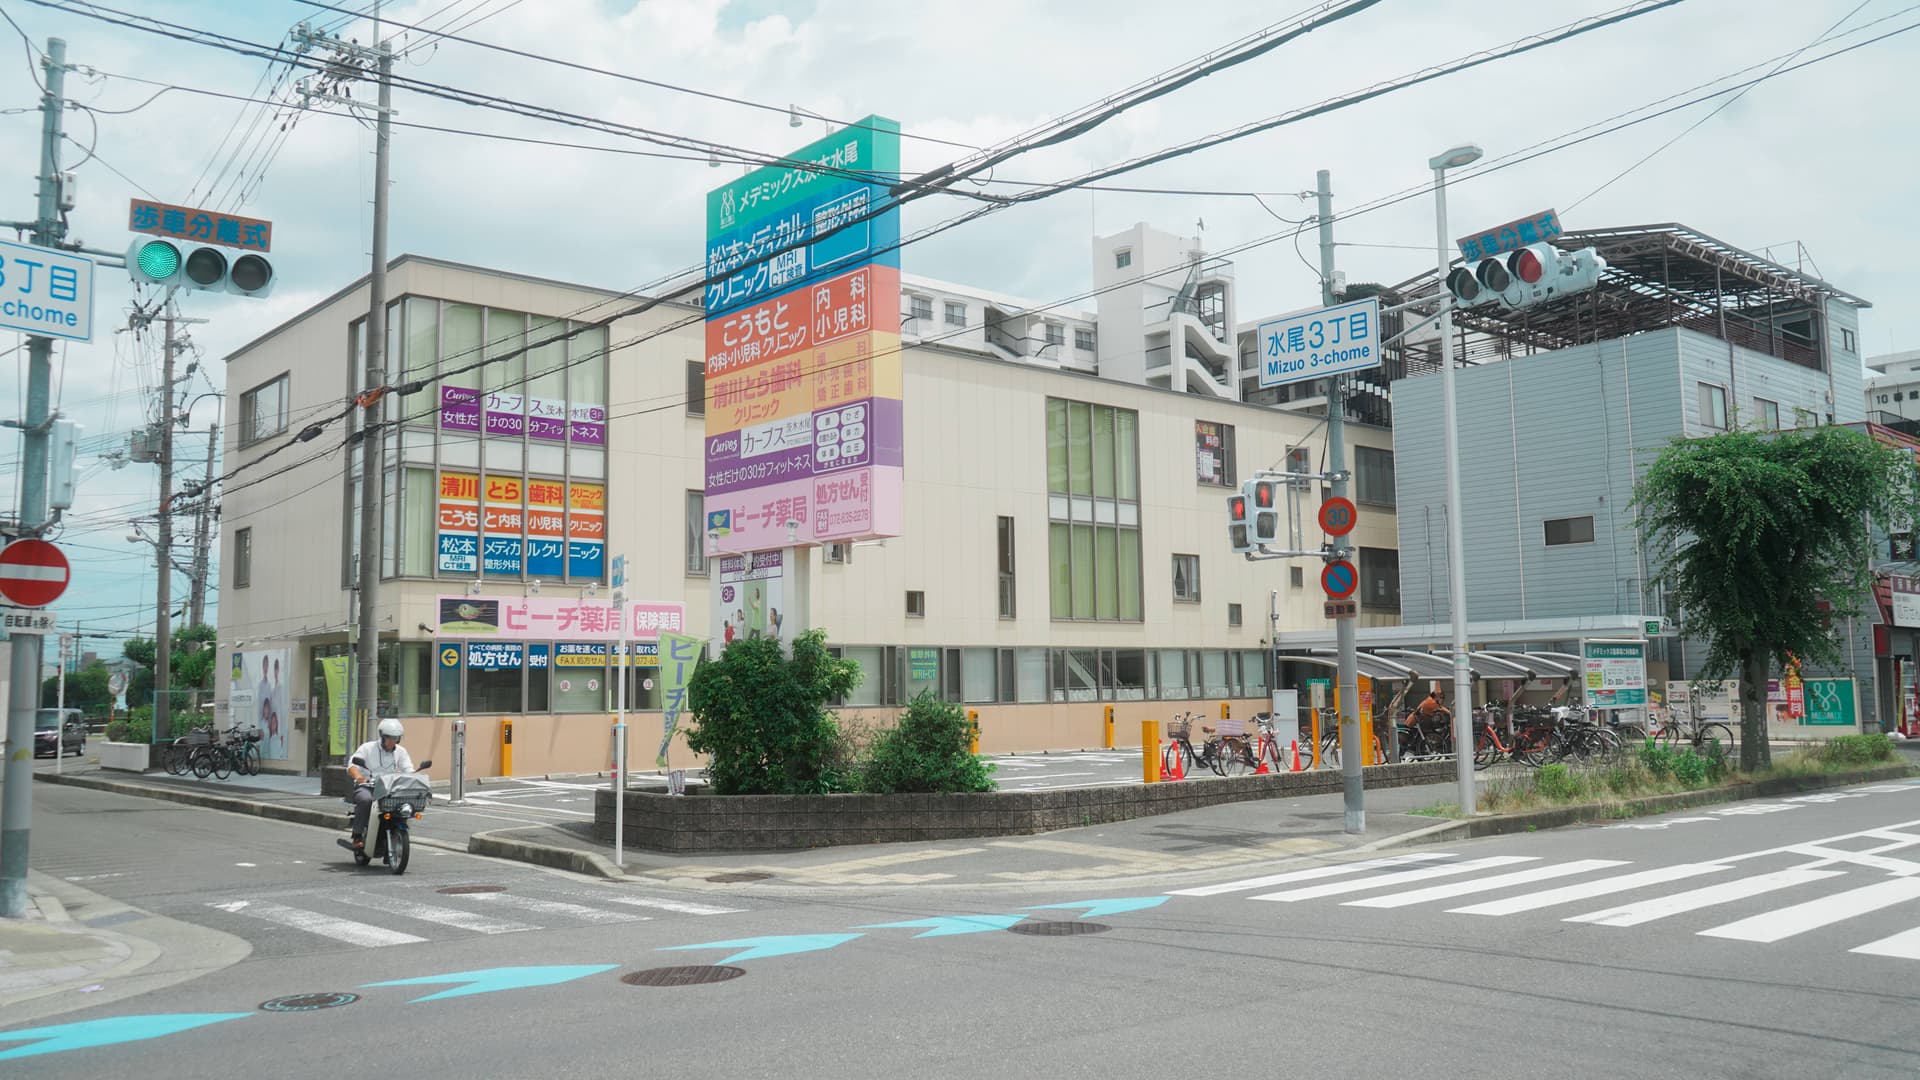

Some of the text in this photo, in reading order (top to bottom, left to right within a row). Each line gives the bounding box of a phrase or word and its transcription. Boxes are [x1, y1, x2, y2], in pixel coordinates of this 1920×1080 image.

[133, 204, 268, 249] 歩車分離式
[1463, 213, 1560, 263] 歩車分離式
[708, 212, 806, 278] 松本メディカル
[776, 251, 798, 269] MRI
[0, 255, 77, 302] 丁目
[708, 263, 769, 311] クリニック
[816, 274, 866, 311] 内科
[722, 301, 790, 347] こうもと
[816, 303, 867, 338] 小児科
[1267, 311, 1368, 358] 水尾3丁目
[1268, 344, 1371, 376] Mizuo 3-chome
[713, 358, 803, 409] 清川とら歯科
[443, 411, 600, 440] 女性だけの30分フィットネス
[734, 398, 780, 425] クリニック
[710, 438, 738, 456] Curves
[708, 453, 811, 489] 女性だけの30分フィットネス
[816, 479, 860, 505] 処方せん
[732, 495, 807, 533] ピーチ薬局
[1327, 508, 1349, 526] 30
[484, 559, 521, 571] 整形外科
[506, 604, 682, 632] ピーチ薬局 保険薬局
[635, 656, 659, 665] 072-63
